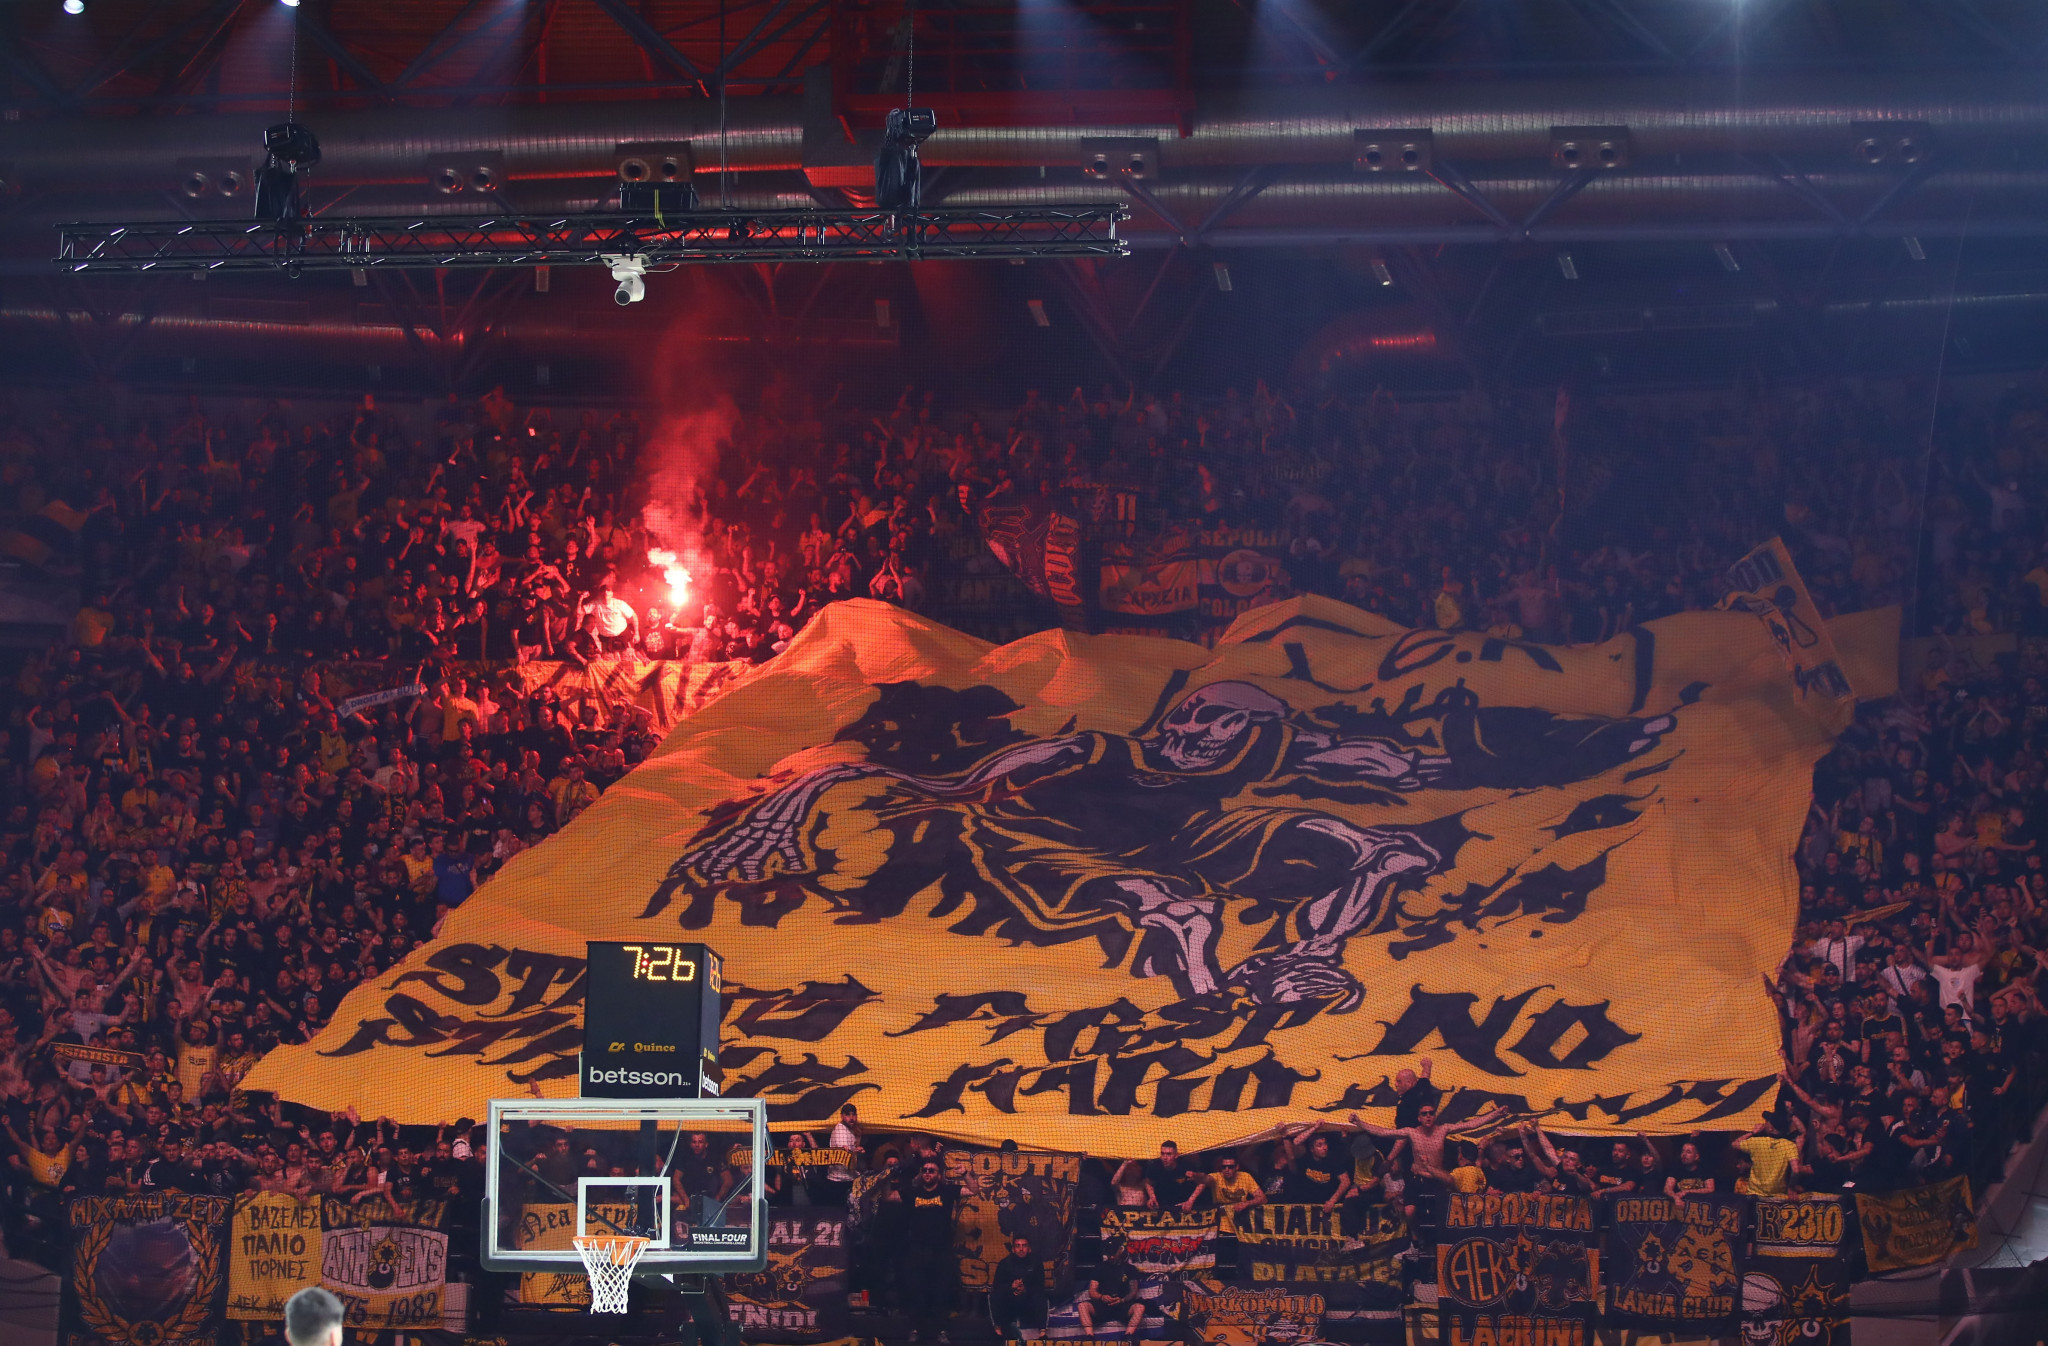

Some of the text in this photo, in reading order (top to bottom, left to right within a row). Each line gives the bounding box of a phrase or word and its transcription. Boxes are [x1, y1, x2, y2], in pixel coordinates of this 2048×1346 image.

[622, 945, 697, 982] 7:26
[1332, 982, 1643, 1077] NO
[633, 1042, 676, 1053] Quince
[589, 1066, 683, 1086] betsson
[943, 1150, 1081, 1184] SOUTH
[520, 1208, 572, 1244] Nea
[814, 1220, 842, 1247] 21
[1719, 1207, 1740, 1234] 21
[241, 1233, 306, 1256] ΠΑΛΙΟ
[692, 1233, 748, 1242] FINAL FOUR
[250, 1259, 310, 1281] ΠΟΡΝΕΣ
[1451, 1241, 1507, 1302] AEK
[387, 1292, 439, 1327] 1982
[1613, 1286, 1735, 1319] LAMIA CLUB
